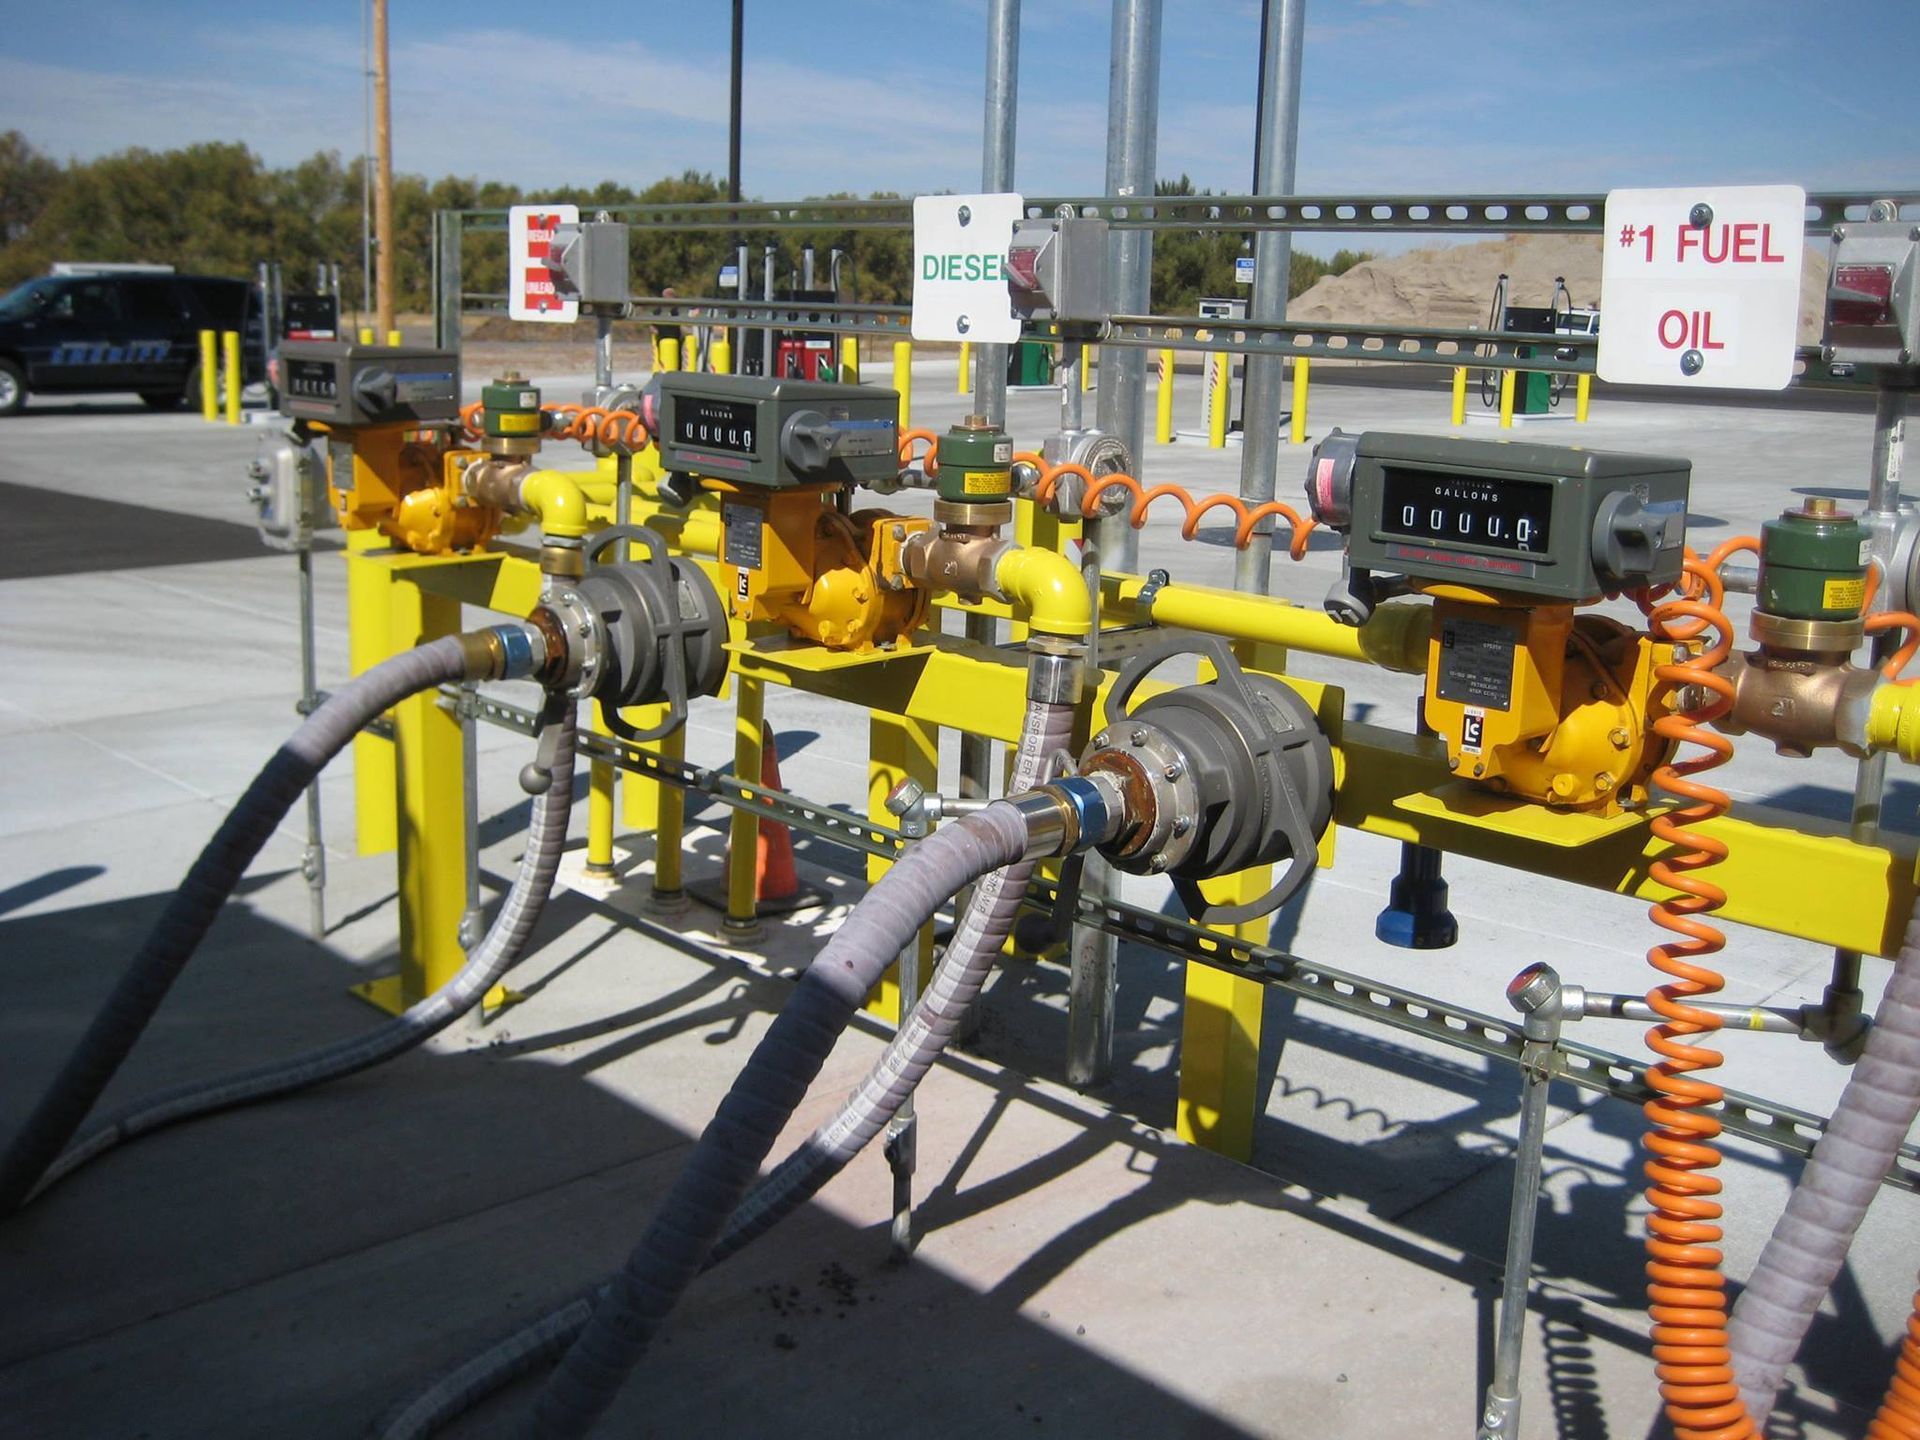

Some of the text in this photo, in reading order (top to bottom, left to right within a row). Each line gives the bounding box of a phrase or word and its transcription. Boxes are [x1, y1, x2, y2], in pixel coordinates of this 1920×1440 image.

[1619, 223, 1784, 263] #1 FUEL
[1657, 309, 1725, 349] OIL
[700, 408, 734, 420] GALLONS
[1434, 486, 1499, 503] GALLONS
